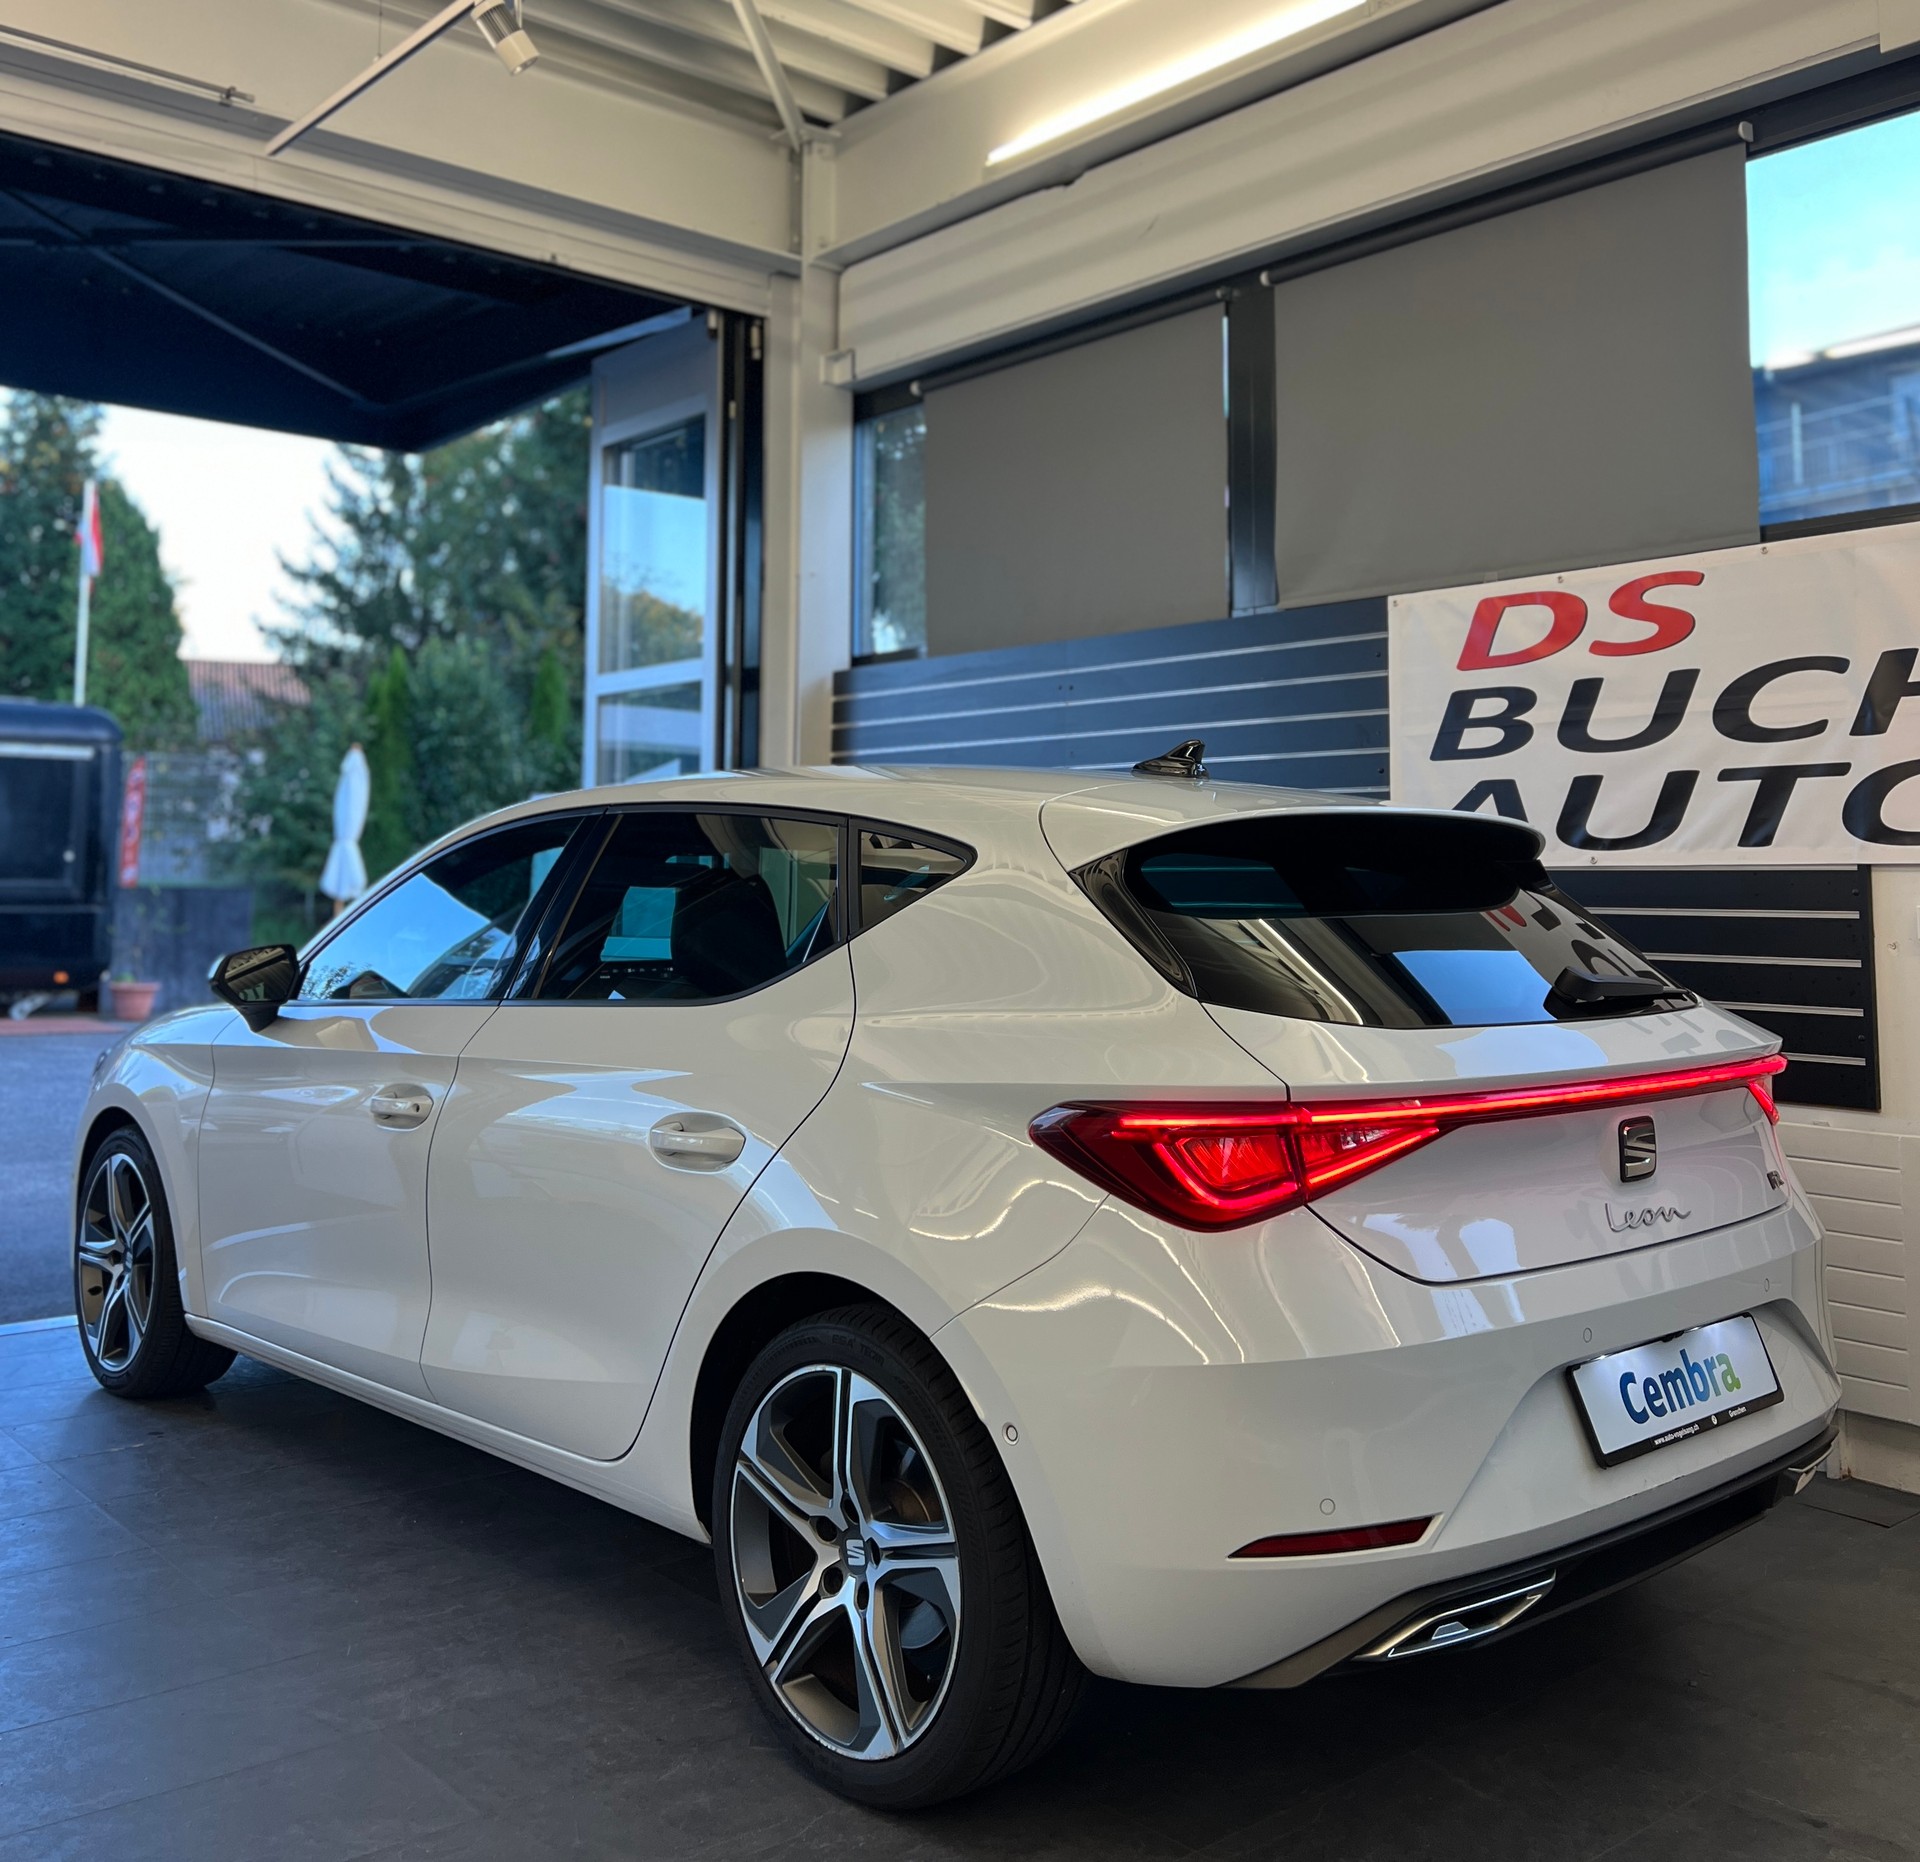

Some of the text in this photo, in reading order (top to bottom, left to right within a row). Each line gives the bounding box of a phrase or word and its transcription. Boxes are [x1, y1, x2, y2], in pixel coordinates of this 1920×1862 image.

[1456, 571, 1705, 672] DS
[1605, 1202, 1692, 1233] Leon
[1619, 1348, 1742, 1425] Cembra
